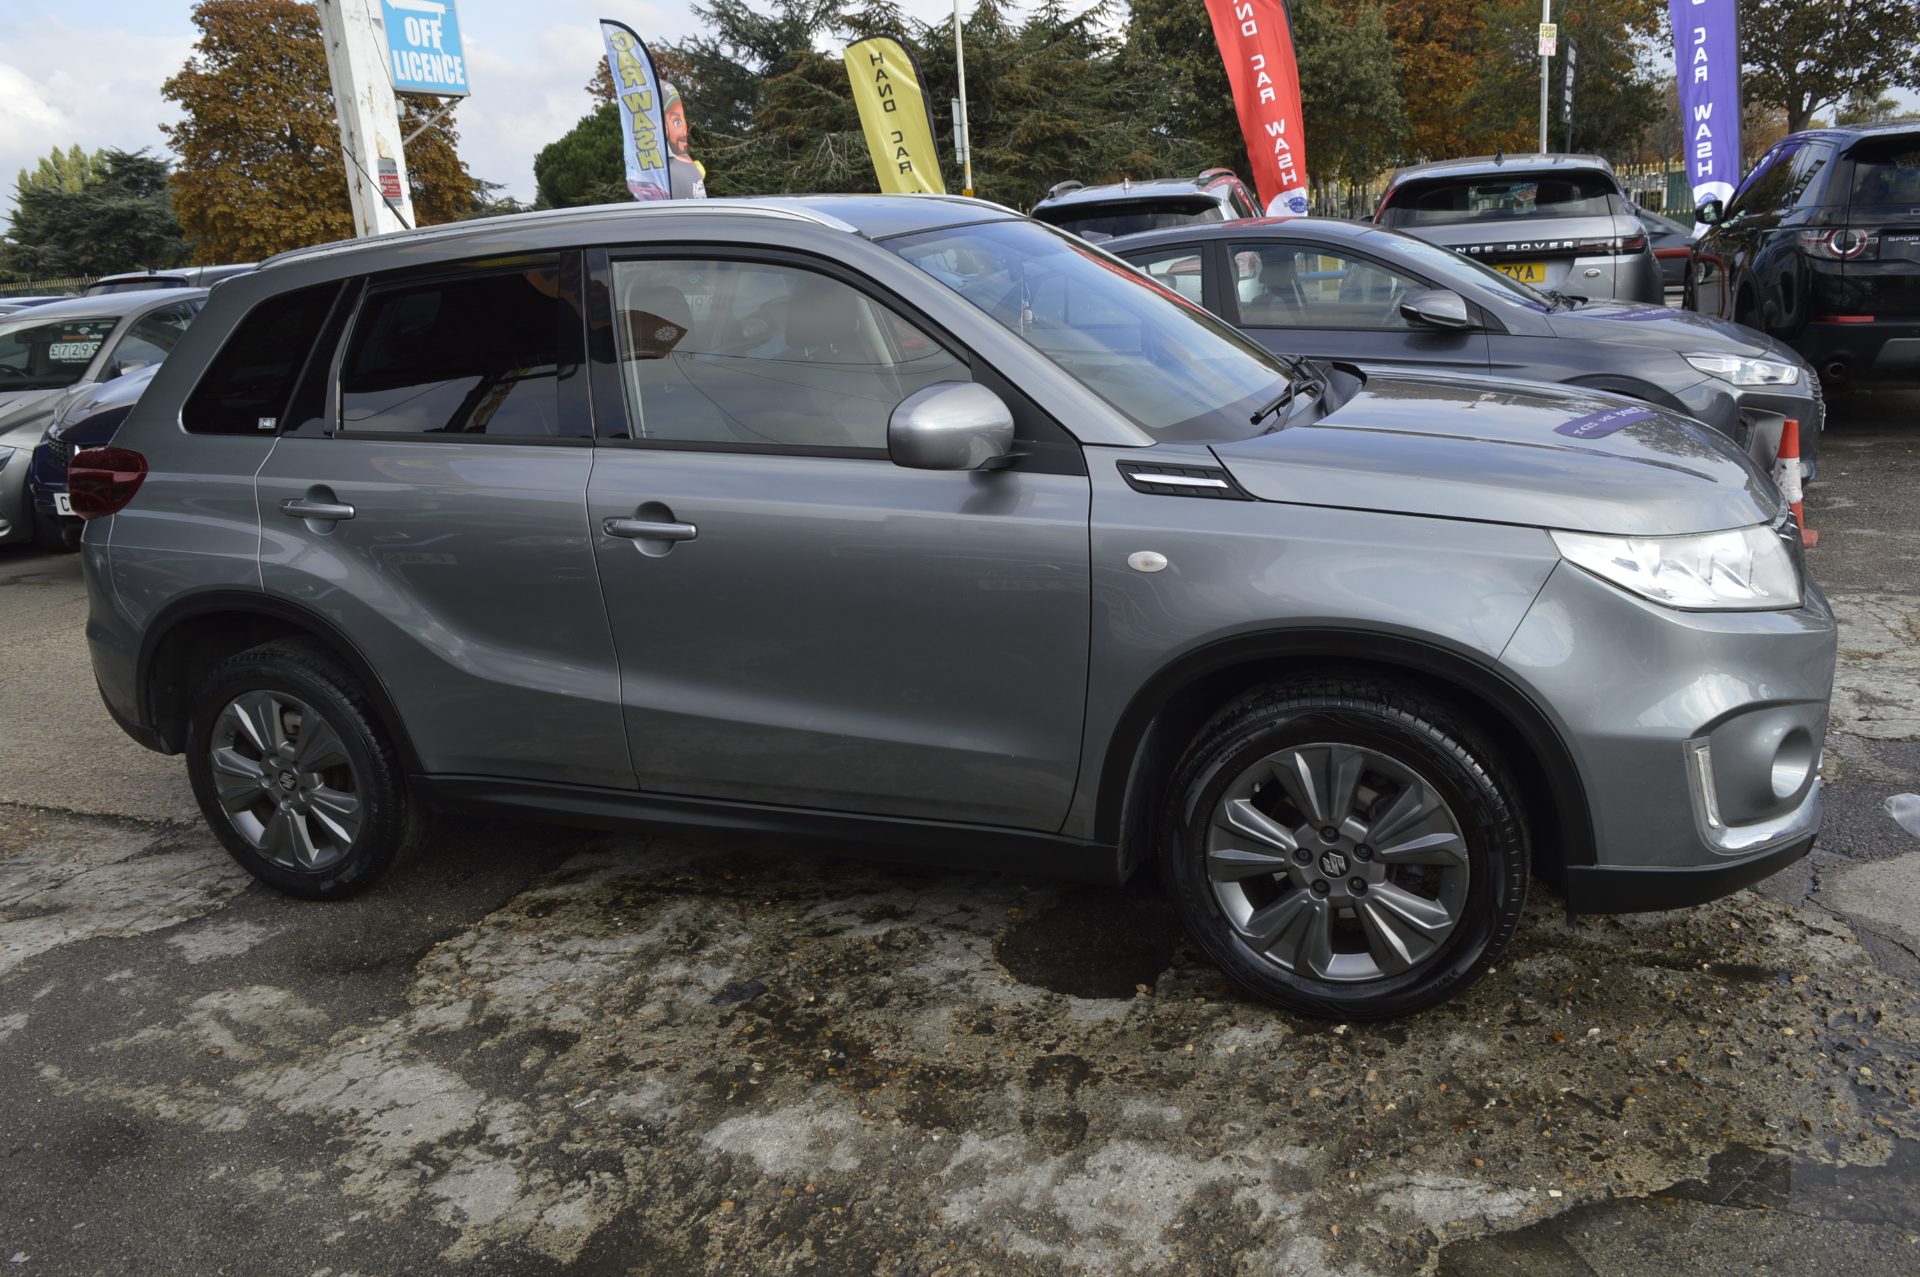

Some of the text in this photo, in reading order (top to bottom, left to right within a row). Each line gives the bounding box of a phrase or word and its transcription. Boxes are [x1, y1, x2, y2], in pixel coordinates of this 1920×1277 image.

[404, 16, 443, 49] OFF
[392, 49, 465, 85] LICENCE
[1456, 241, 1574, 254] NGE ROVER
